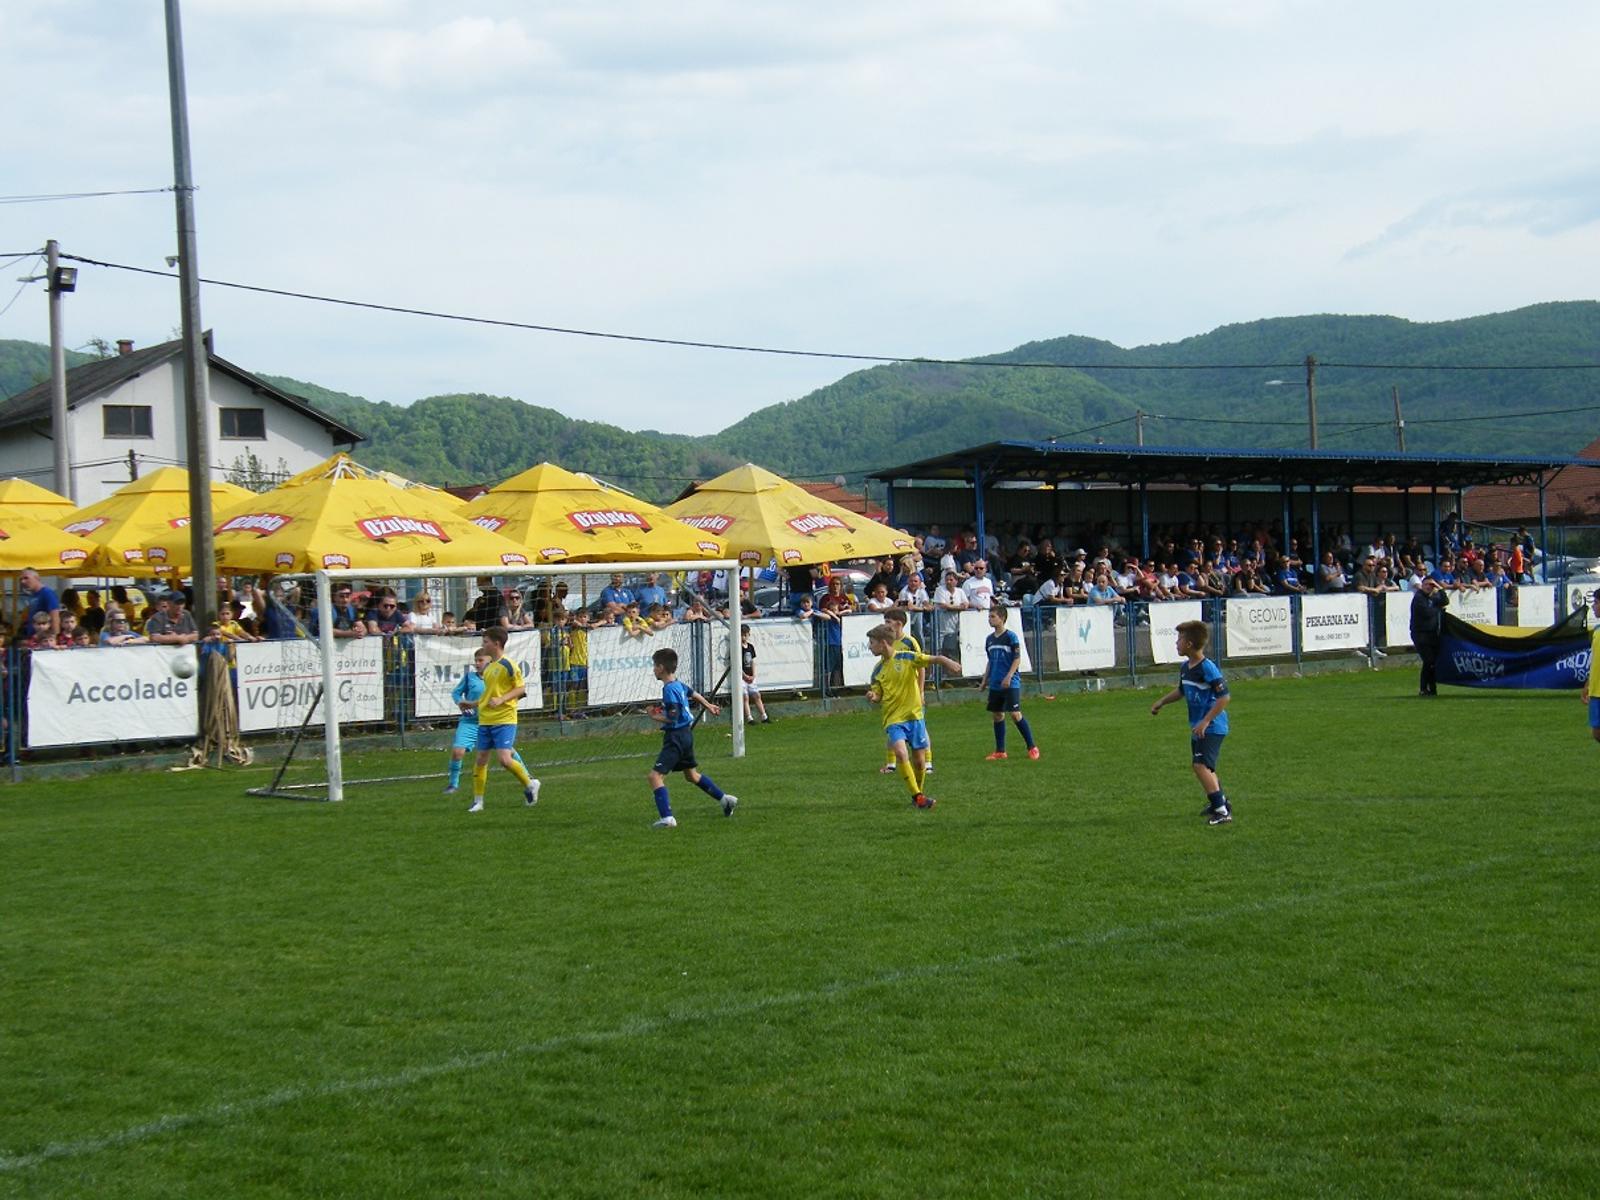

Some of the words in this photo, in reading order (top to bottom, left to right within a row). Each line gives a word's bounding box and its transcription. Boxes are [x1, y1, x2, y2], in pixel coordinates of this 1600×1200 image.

[1249, 607, 1288, 623] GEOVID
[1306, 614, 1342, 627] PEKARNA
[244, 662, 313, 675] Održavanje
[592, 655, 653, 671] MESSER
[67, 677, 188, 704] Accolade
